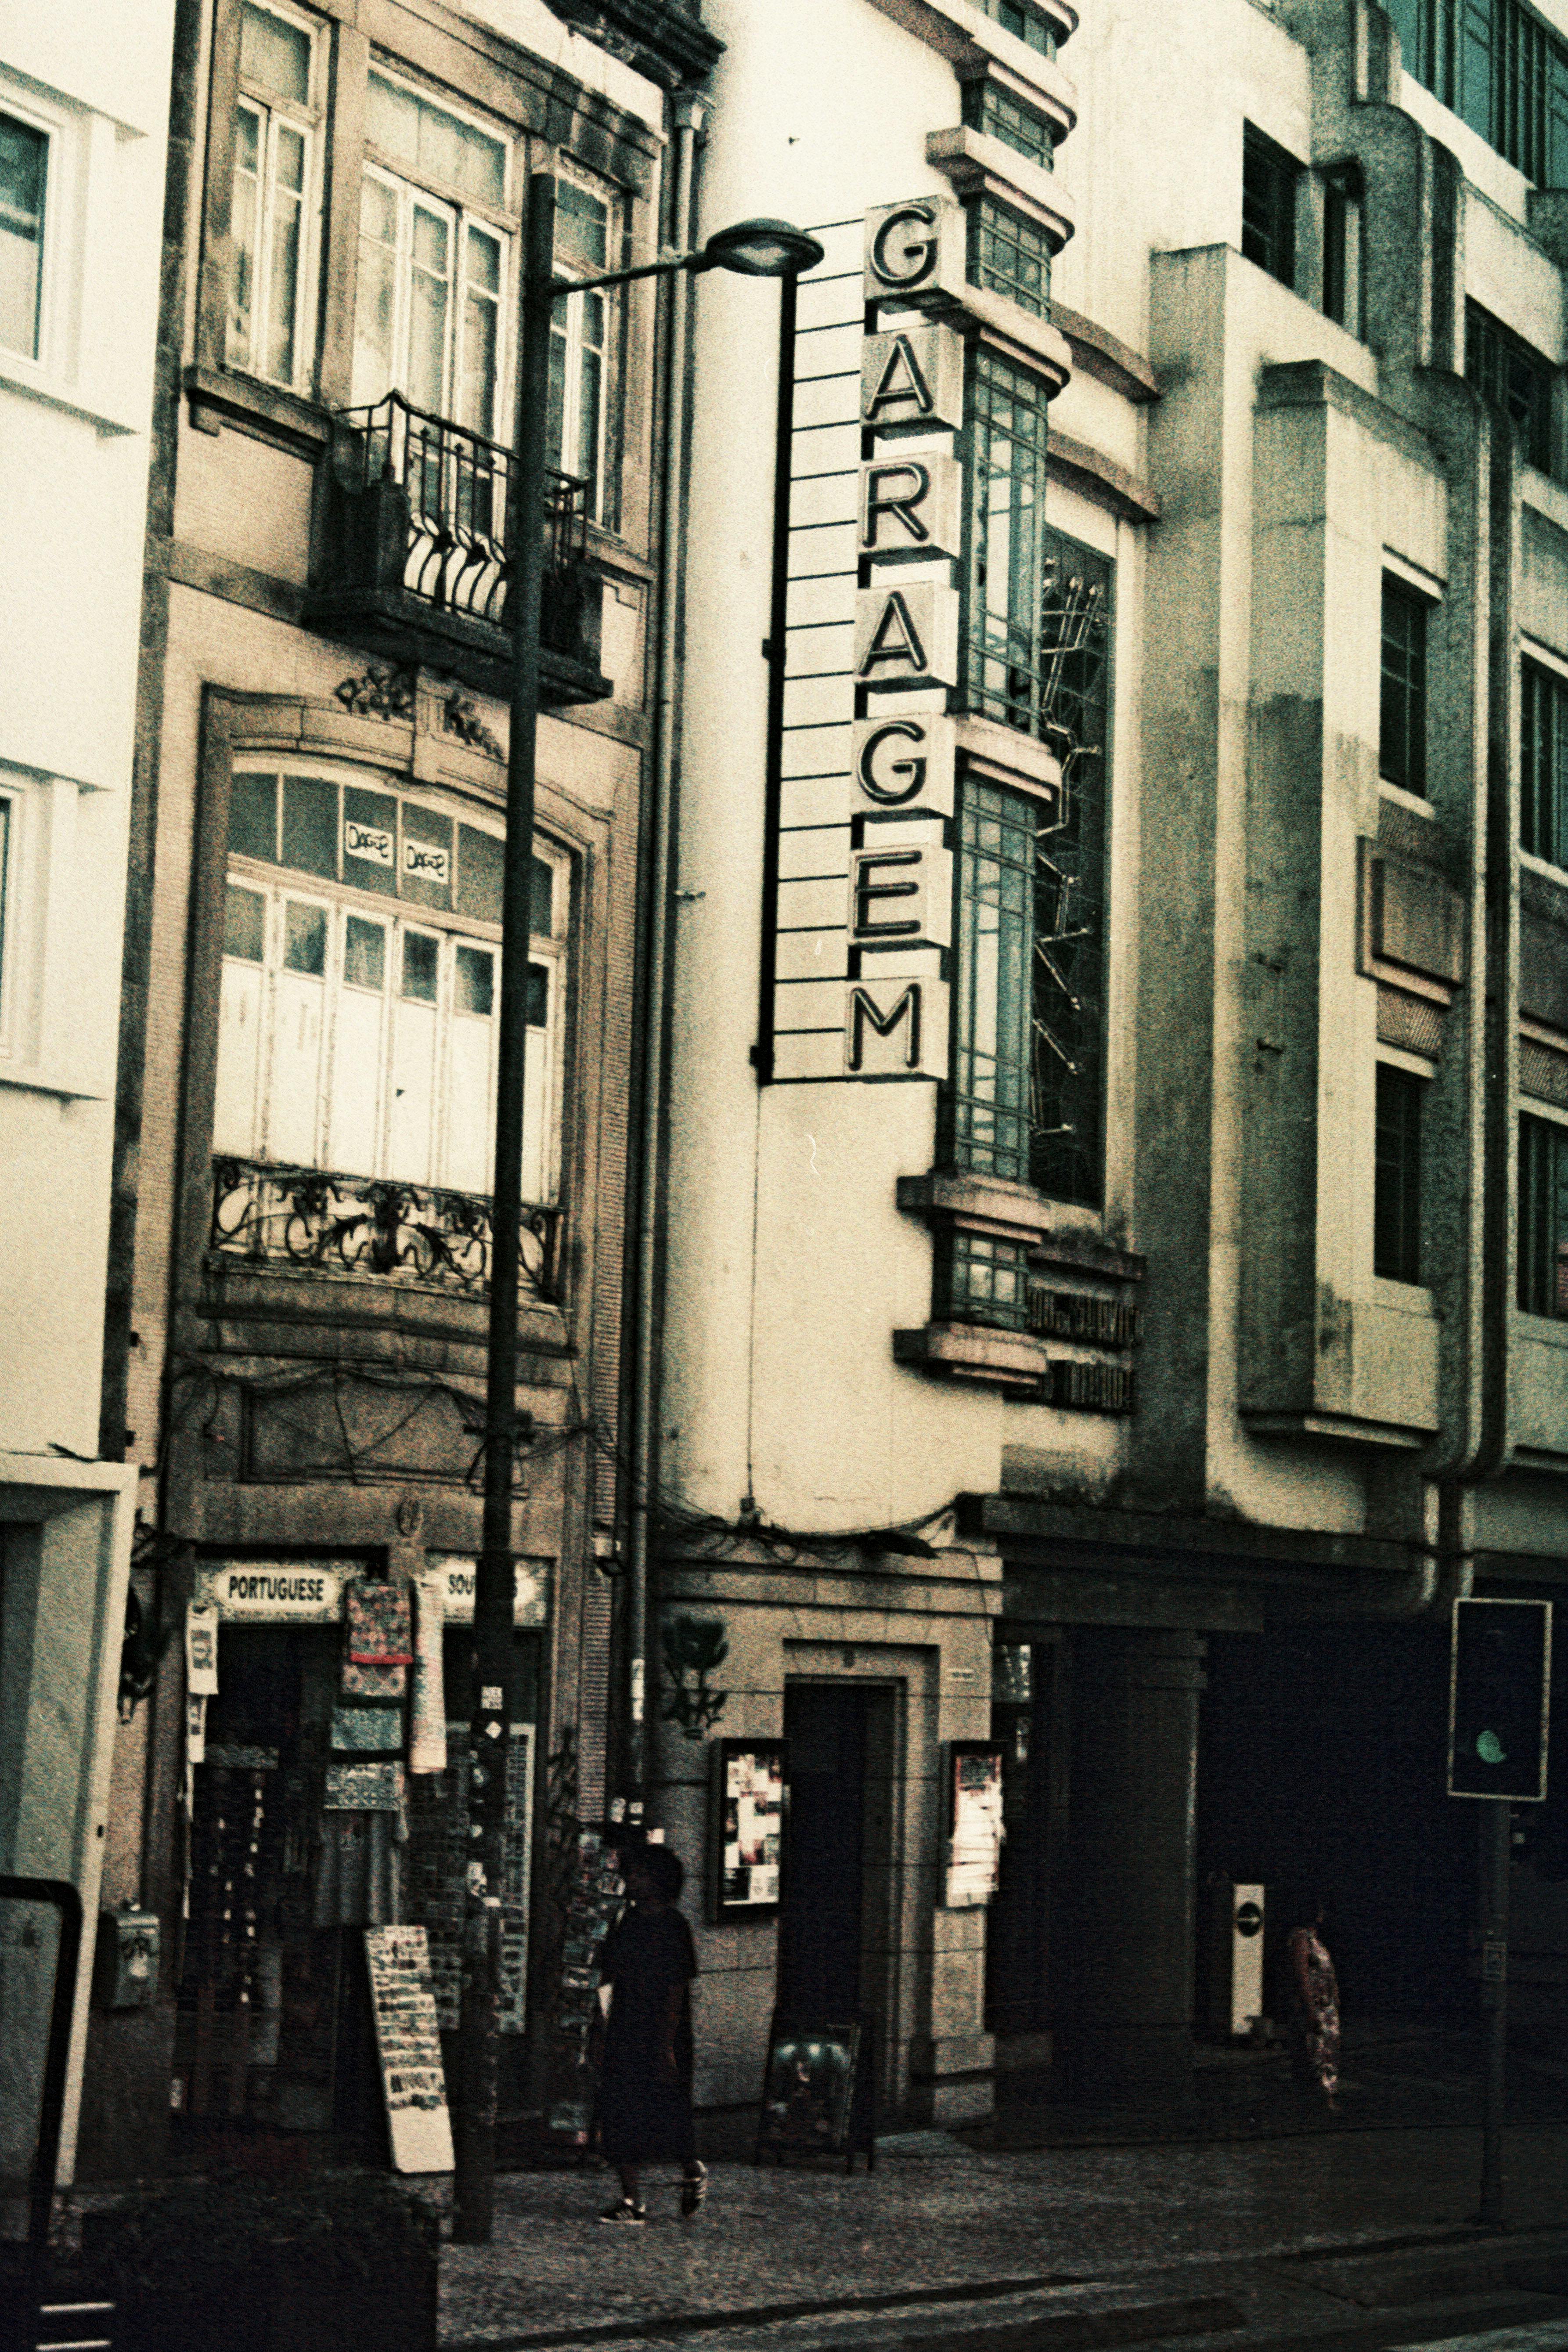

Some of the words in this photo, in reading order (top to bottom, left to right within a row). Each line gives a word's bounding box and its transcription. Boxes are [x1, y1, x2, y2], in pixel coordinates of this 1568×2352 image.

[847, 205, 937, 1071] GARAGEM
[228, 1575, 324, 1601] PORTUGUESE
[448, 1573, 476, 1595] SOU
